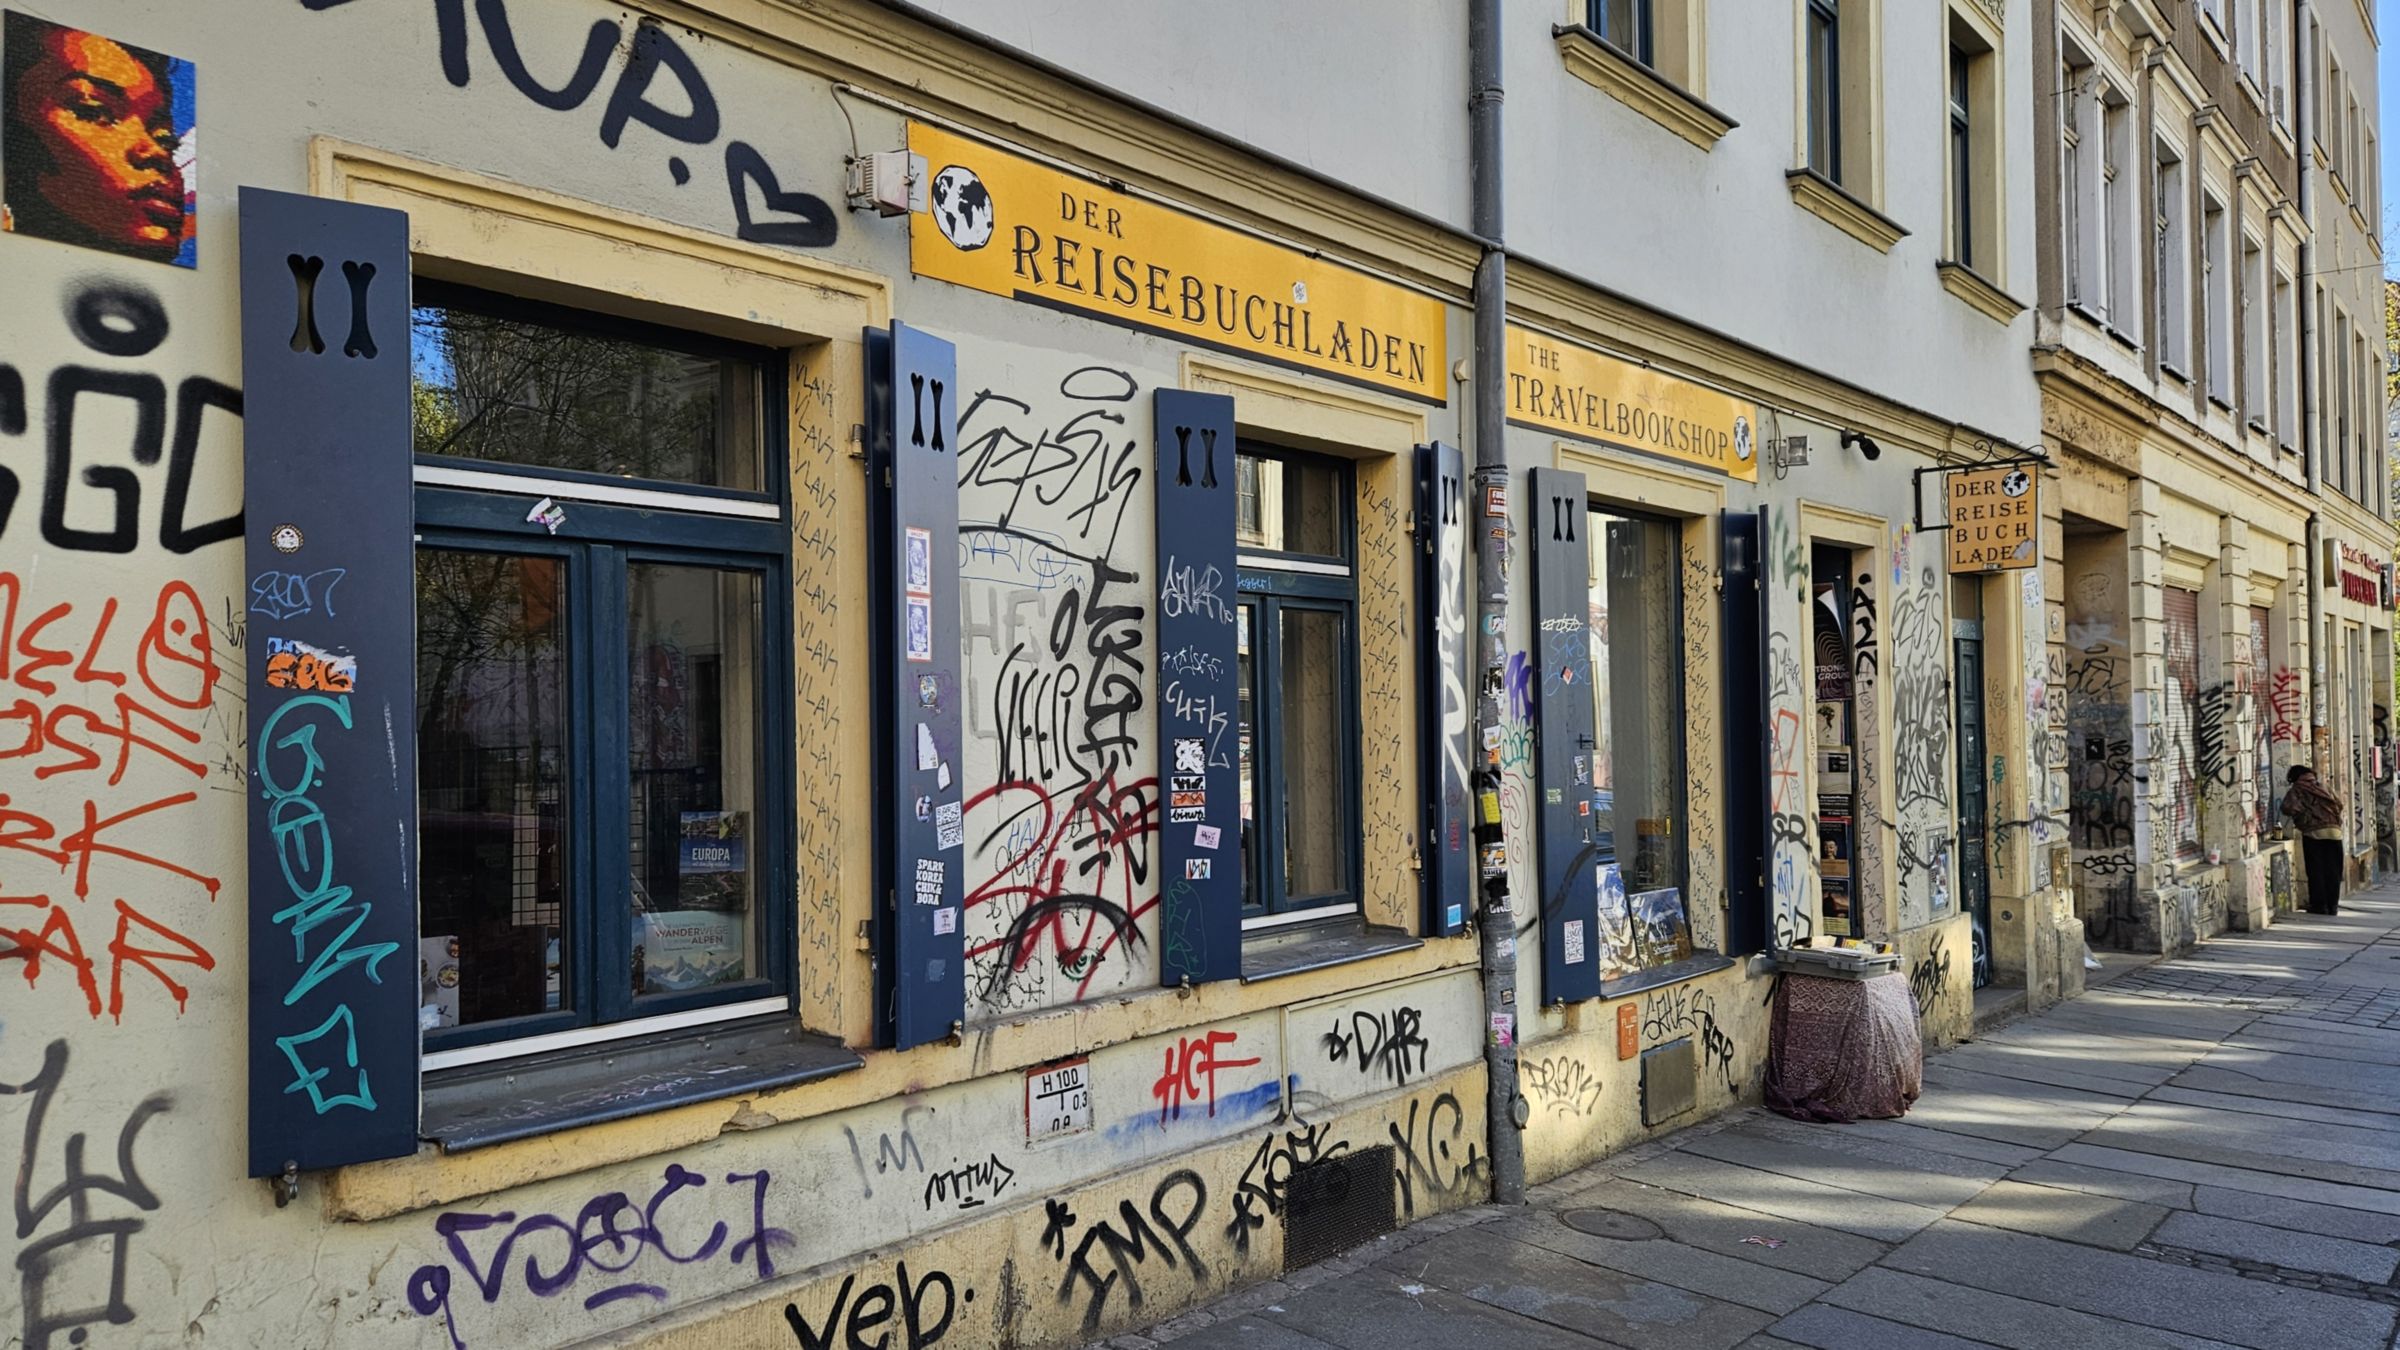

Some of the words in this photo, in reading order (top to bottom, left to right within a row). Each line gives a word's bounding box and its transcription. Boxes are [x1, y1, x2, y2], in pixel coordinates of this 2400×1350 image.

[1061, 191, 1124, 239] DER
[1011, 224, 1428, 385] REISEBUCHLADEN
[1527, 343, 1560, 371] THE
[1511, 372, 1729, 460] TRAVELBOOKSHOP
[1955, 480, 1996, 498] DER
[1956, 500, 2028, 522] REISE
[1956, 522, 2027, 543] BUCH
[1955, 544, 2024, 564] LADE
[692, 848, 730, 861] EUROPA
[917, 859, 944, 872] SPARK
[916, 870, 943, 883] KOREA
[916, 892, 939, 905] BORA
[691, 935, 723, 945] ALPEN
[1042, 1074, 1052, 1093] H
[1056, 1068, 1079, 1088] 100
[1072, 1091, 1088, 1111] 0,3
